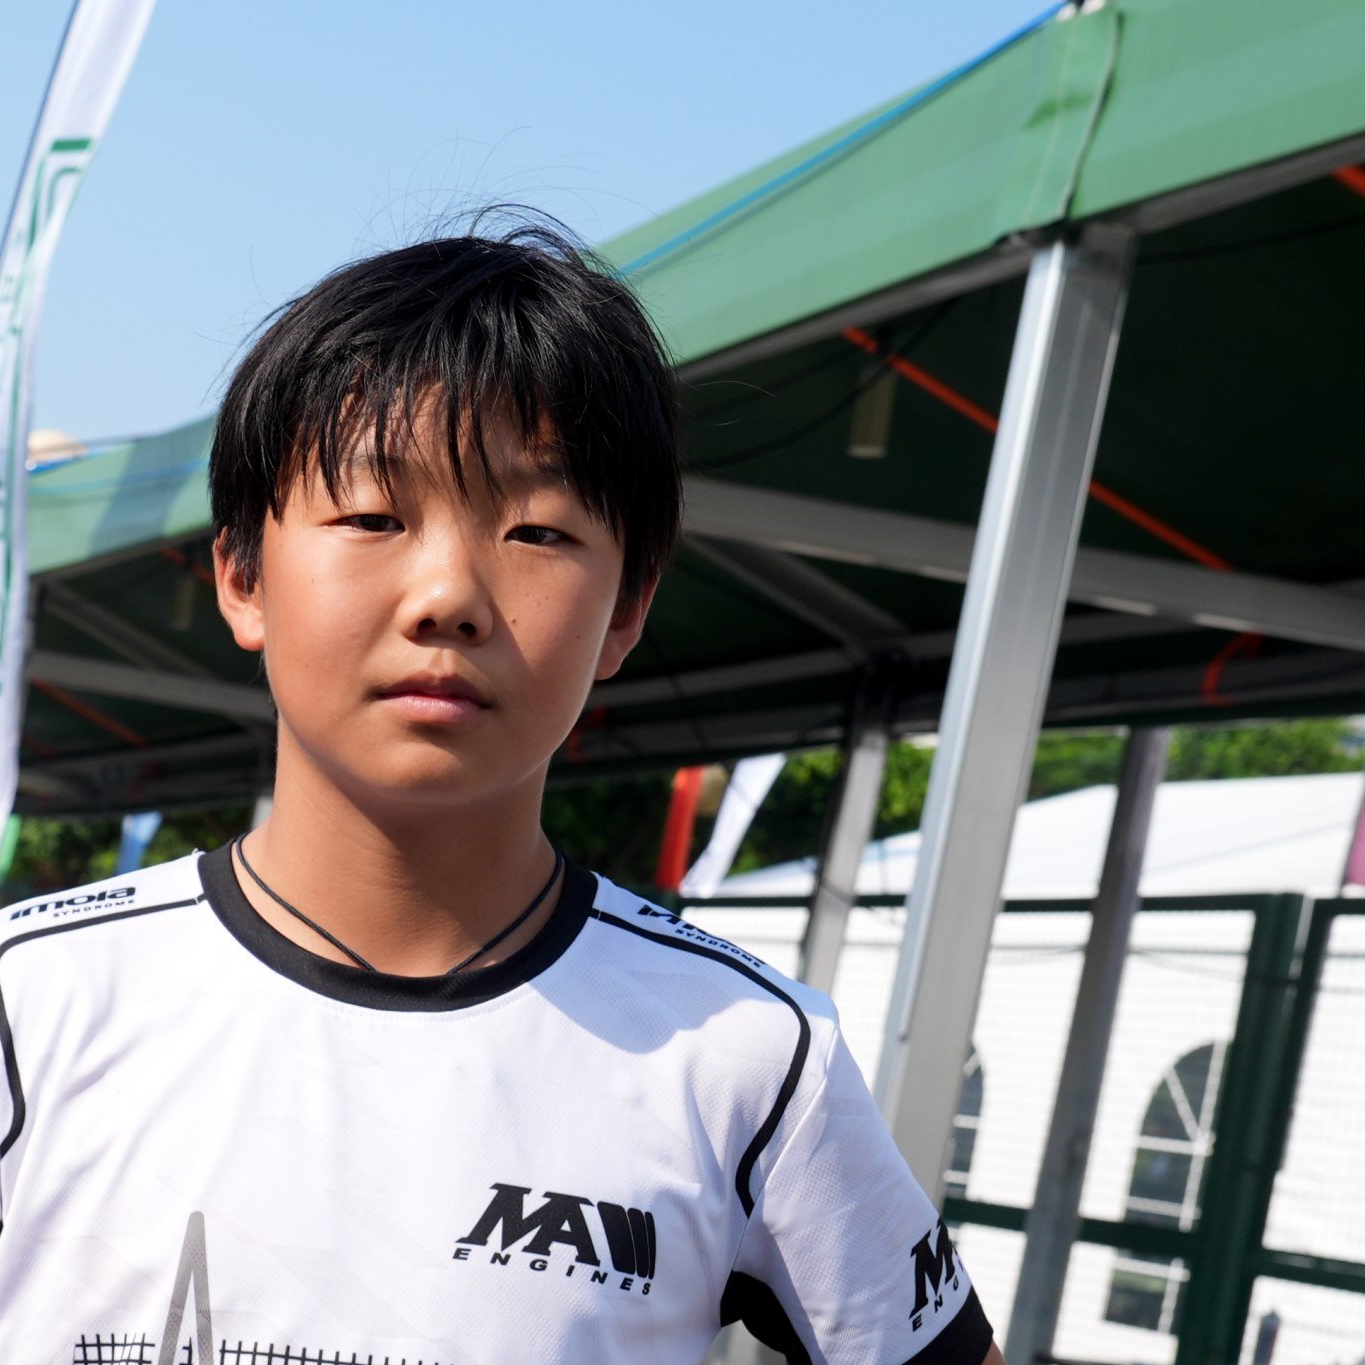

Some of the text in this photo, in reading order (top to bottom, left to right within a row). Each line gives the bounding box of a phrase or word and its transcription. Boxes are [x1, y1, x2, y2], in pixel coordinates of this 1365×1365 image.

[9, 886, 136, 921] imola
[53, 899, 136, 918] SYNDROME
[675, 928, 762, 968] SYNDROME
[452, 1247, 651, 1295] ENGINES
